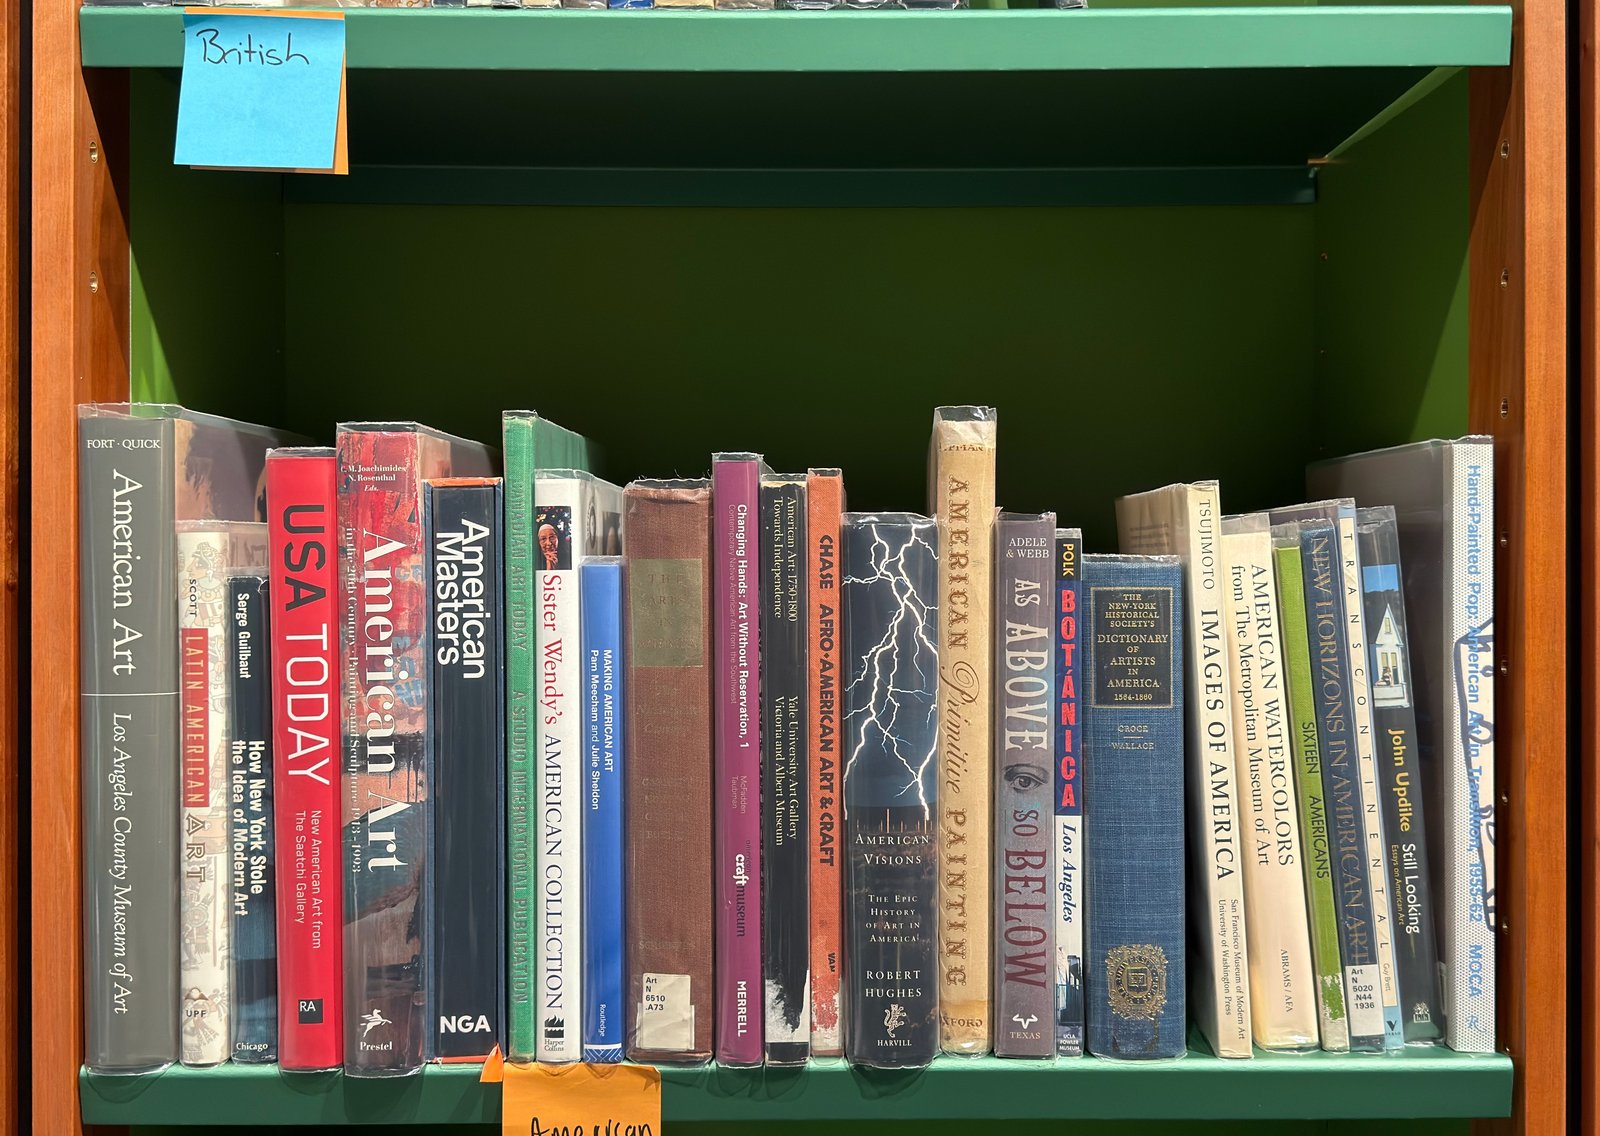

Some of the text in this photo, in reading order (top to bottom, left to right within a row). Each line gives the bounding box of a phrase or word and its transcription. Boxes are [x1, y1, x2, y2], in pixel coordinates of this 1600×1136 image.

[196, 28, 310, 66] British
[87, 439, 161, 450] FORT QUICK
[112, 468, 143, 676] American Art
[189, 579, 198, 618] SCOTT
[436, 532, 465, 666] Masters
[461, 518, 490, 679] American
[772, 497, 783, 618] Towards Independence
[787, 496, 798, 622] American Art: 1750-1800
[948, 475, 970, 650] AMERICAN
[1008, 537, 1047, 547] ADELE
[1016, 549, 1049, 558] WEBB
[1062, 543, 1074, 577] POLK
[236, 593, 252, 679] Serge Guilbaut
[283, 504, 330, 786] USA TODAY
[736, 504, 749, 739] Changing Hands: Art Without Reservation,
[1004, 578, 1049, 751] AS ABOVE
[1097, 634, 1168, 643] DICTIONARY
[1107, 678, 1160, 688] AMERICA
[1110, 620, 1155, 628] SOCIETY'S
[1110, 656, 1156, 666] ARTISTS
[1198, 499, 1235, 880] TSUJIMOTO IMAGES OF AMERICA
[186, 636, 206, 883] LATIN AMERICAN ART
[363, 527, 412, 873] American Art
[590, 650, 601, 810] Pam Meecham and Julie Sheldon
[603, 649, 614, 772] MAKING AMERICAN ART
[786, 696, 800, 839] Yale University Art Gallery
[819, 534, 834, 866] CHASE ART CRAFT
[940, 660, 980, 793] Primitive
[1231, 565, 1271, 866] from The Metropolitan Museum of Art
[1251, 564, 1295, 866] AMERICAN WATERCOLORS
[1311, 535, 1370, 965] NEW HORIZONS IN AMERICAN ART
[1465, 465, 1484, 997] Hand-Painted Pop: American Art in Transition, 1955-62 MOCA
[233, 740, 249, 916] the Idea of Modern Art
[249, 740, 267, 894] How New York Stole
[540, 574, 563, 1010] Sister Wendy's AMERICAN COLLECTION
[775, 696, 786, 846] Victoria and Albert Museum
[1302, 721, 1329, 879] SIXTEEN AMERICANS
[1388, 729, 1422, 934] John Updike Still Looking
[109, 713, 132, 1014] Los Angeles County Museum of Art
[294, 811, 307, 924] The Saatchi Gallery
[311, 810, 323, 949] New American Art from
[946, 806, 968, 986] PAINTING
[1004, 809, 1047, 989] SO BELOW
[1058, 823, 1077, 923] Los Angeles
[440, 1015, 492, 1033] NGA
[598, 1004, 607, 1037] Routledge
[737, 980, 747, 1037] MERRELL
[865, 987, 922, 999] HUGHES
[866, 969, 921, 981] ROBERT
[1009, 1031, 1041, 1039] TEXAS
[1230, 899, 1246, 1040] San Francisco Museum Modern Art
[1355, 1002, 1375, 1010] 1936
[236, 1042, 269, 1052] Chicago
[359, 1042, 393, 1050] Prestel
